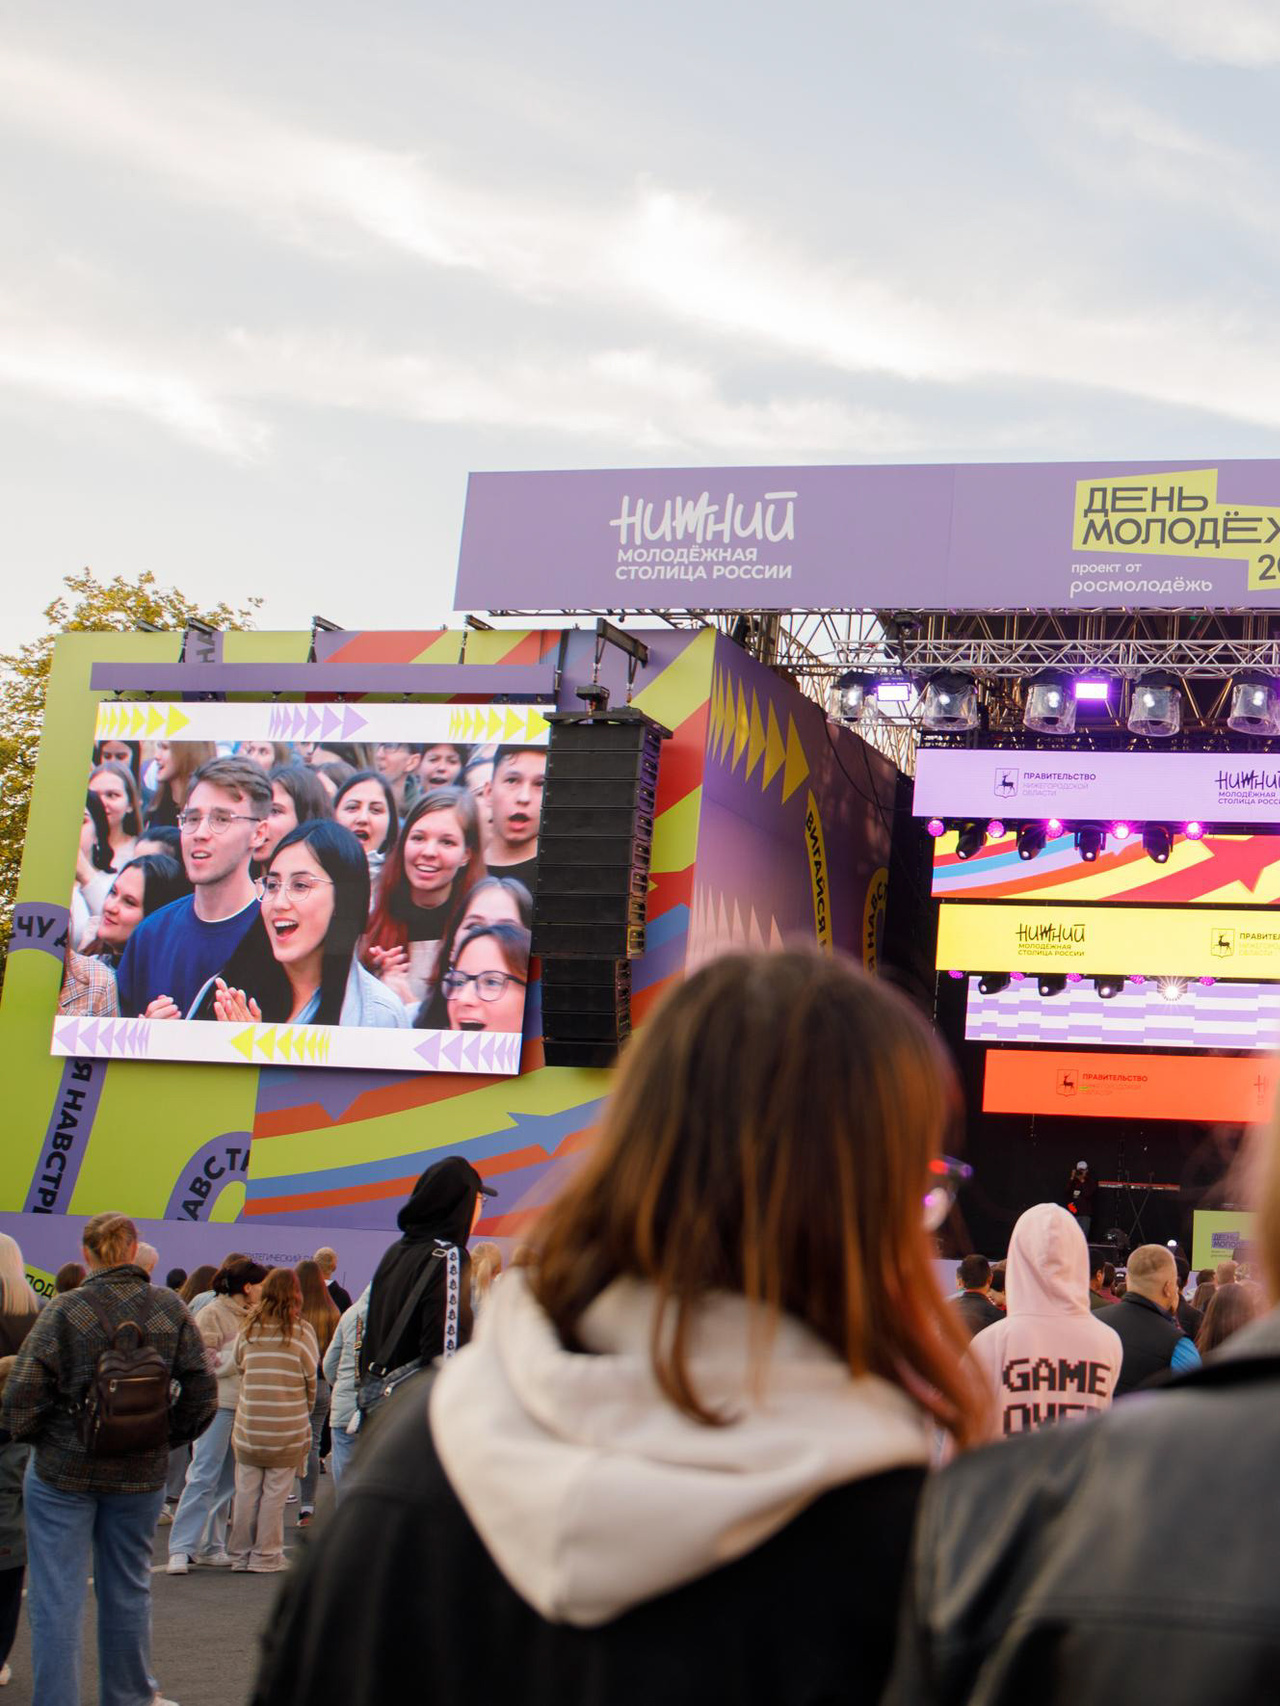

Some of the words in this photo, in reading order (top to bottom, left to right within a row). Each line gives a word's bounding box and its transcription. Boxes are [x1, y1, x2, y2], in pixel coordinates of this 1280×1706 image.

[1083, 486, 1209, 518] ДЕНЬ
[609, 491, 798, 545] НИЖНИЙ
[617, 545, 758, 564] МОЛОДЁЖНАЯ
[615, 565, 707, 582] СТОЛИЦА
[712, 565, 793, 580] РОССИИ
[1071, 563, 1121, 576] проект
[1125, 563, 1142, 574] от
[1069, 576, 1213, 599] росмолодёжь
[1023, 772, 1097, 781] ПРАВИТЕЛЬСТВО
[1015, 923, 1086, 942] НИЖНИЙ
[1082, 1073, 1148, 1082] ПРАВИТЕЛЬСТВО
[177, 1148, 250, 1221] АВСТ
[1003, 1358, 1111, 1397] GAME
[1003, 1403, 1102, 1434] OV
